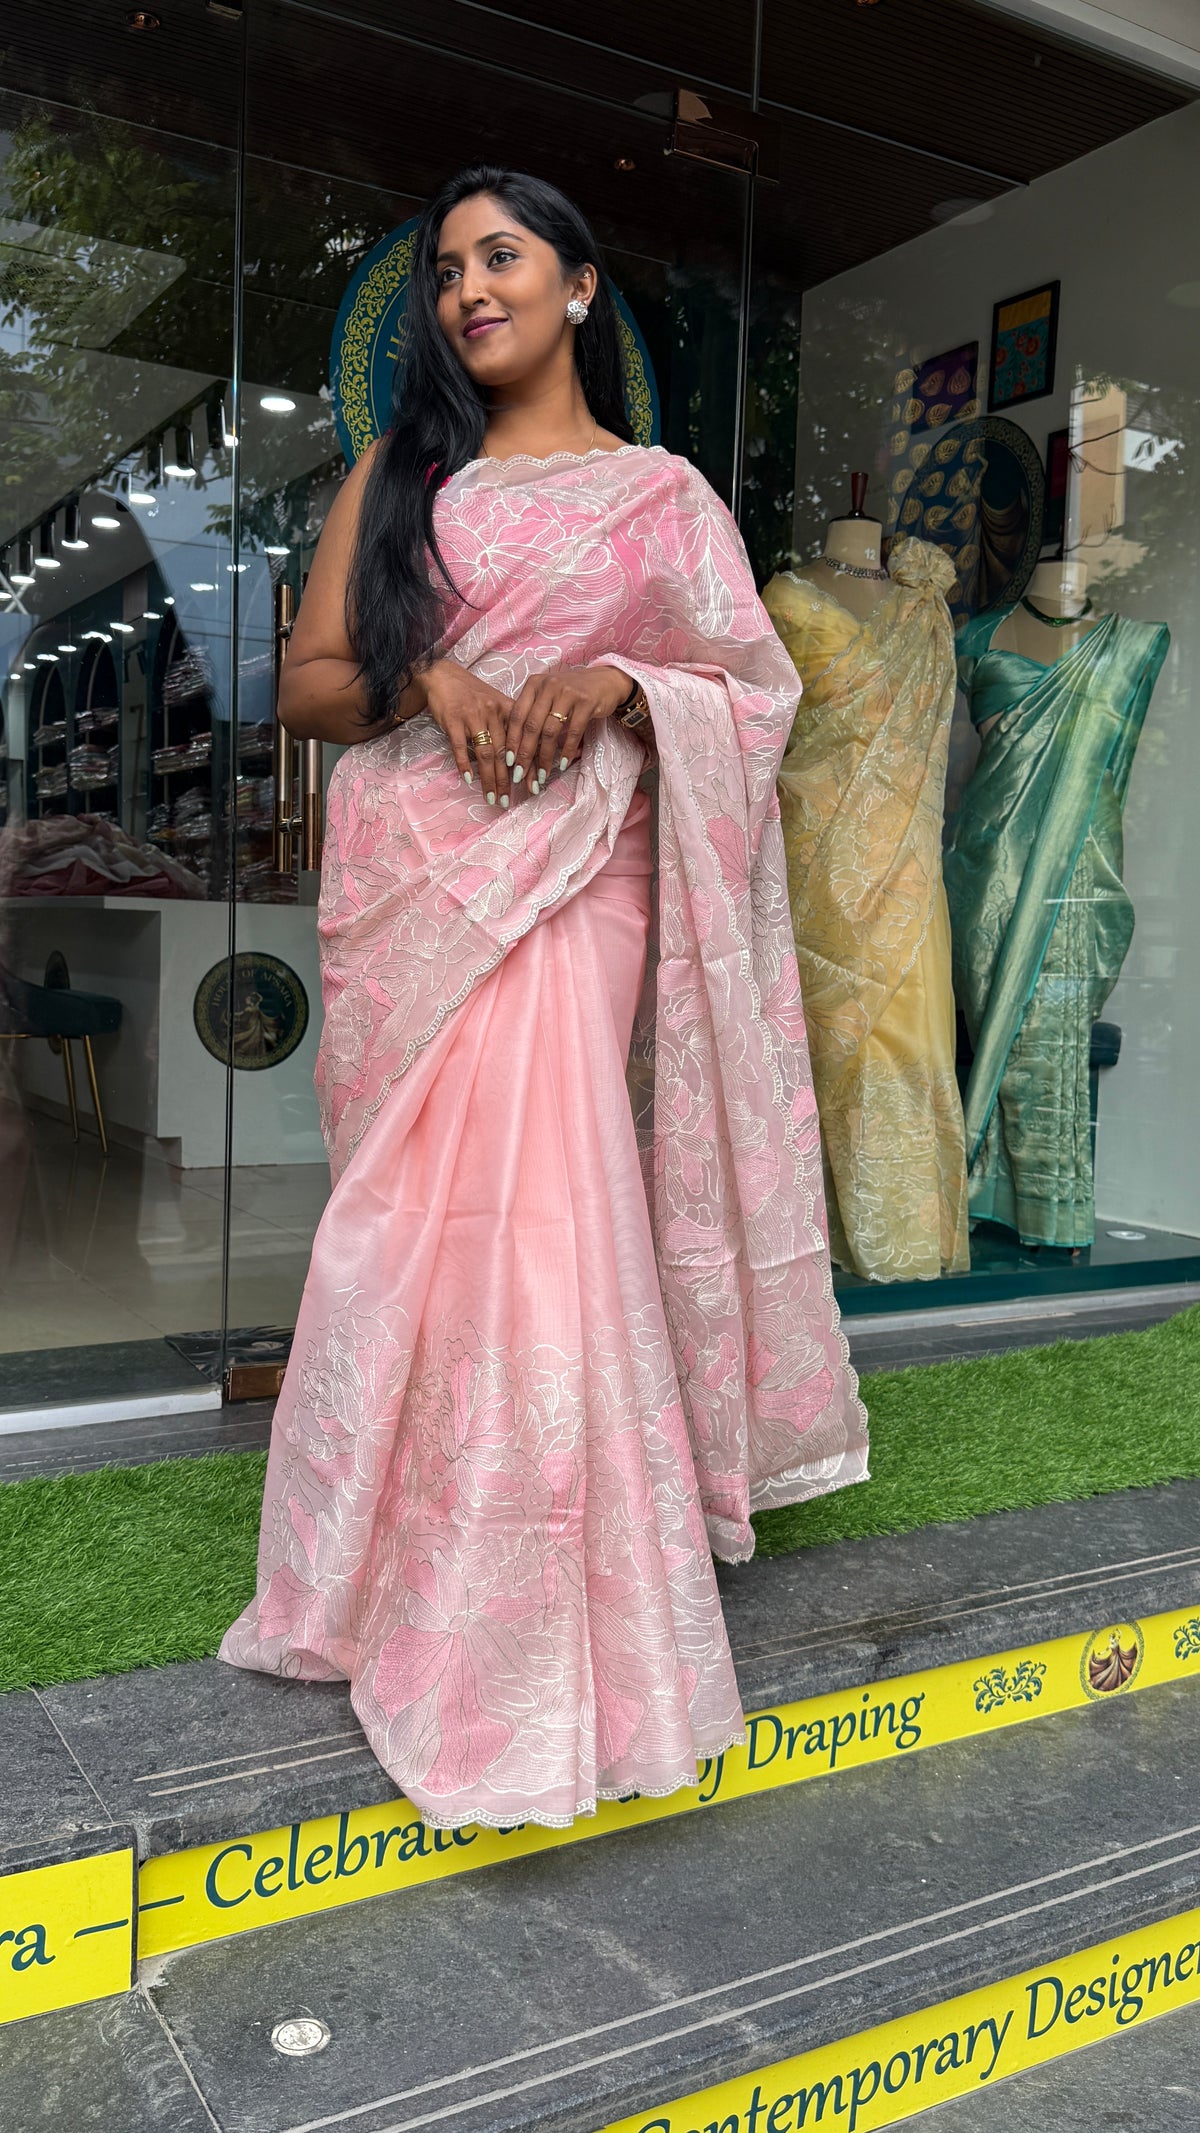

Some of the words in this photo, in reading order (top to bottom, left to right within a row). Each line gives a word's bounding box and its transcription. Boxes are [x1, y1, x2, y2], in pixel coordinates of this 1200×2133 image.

[864, 547, 876, 560] 12
[745, 1692, 925, 1768] Draping
[638, 2009, 1014, 2133] temporary
[1025, 1940, 1200, 2025] Designe
